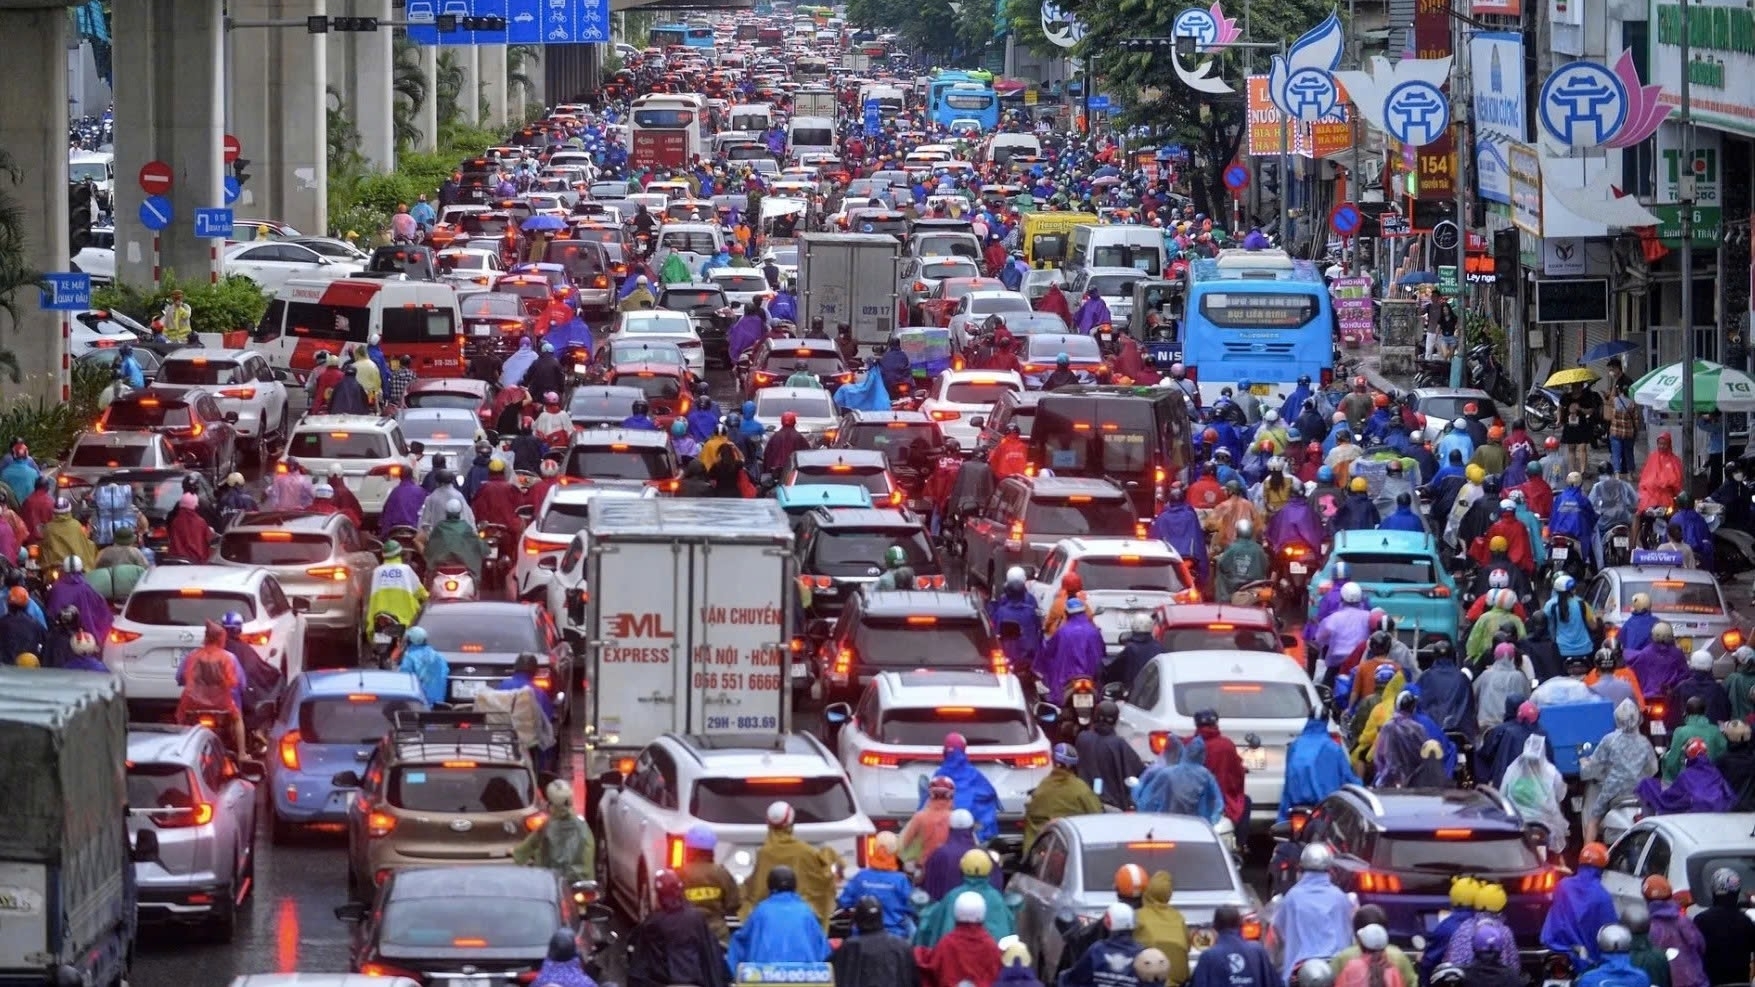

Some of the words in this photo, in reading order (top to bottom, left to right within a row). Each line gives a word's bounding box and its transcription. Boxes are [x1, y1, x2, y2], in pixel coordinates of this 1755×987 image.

[1254, 128, 1271, 137] BIA
[1421, 155, 1447, 174] 154
[61, 281, 70, 290] XE
[57, 294, 74, 303] QUAY
[1725, 382, 1750, 392] TCI
[381, 568, 403, 579] ACB
[700, 606, 726, 628] VẬN
[603, 647, 670, 664] EXPRESS
[694, 646, 711, 664] HÀ
[716, 645, 738, 669] NỘI
[694, 673, 717, 689] 056
[721, 673, 744, 690] 551
[748, 673, 781, 691] 6666
[707, 716, 729, 729] 29H
[737, 716, 776, 729] 803.69
